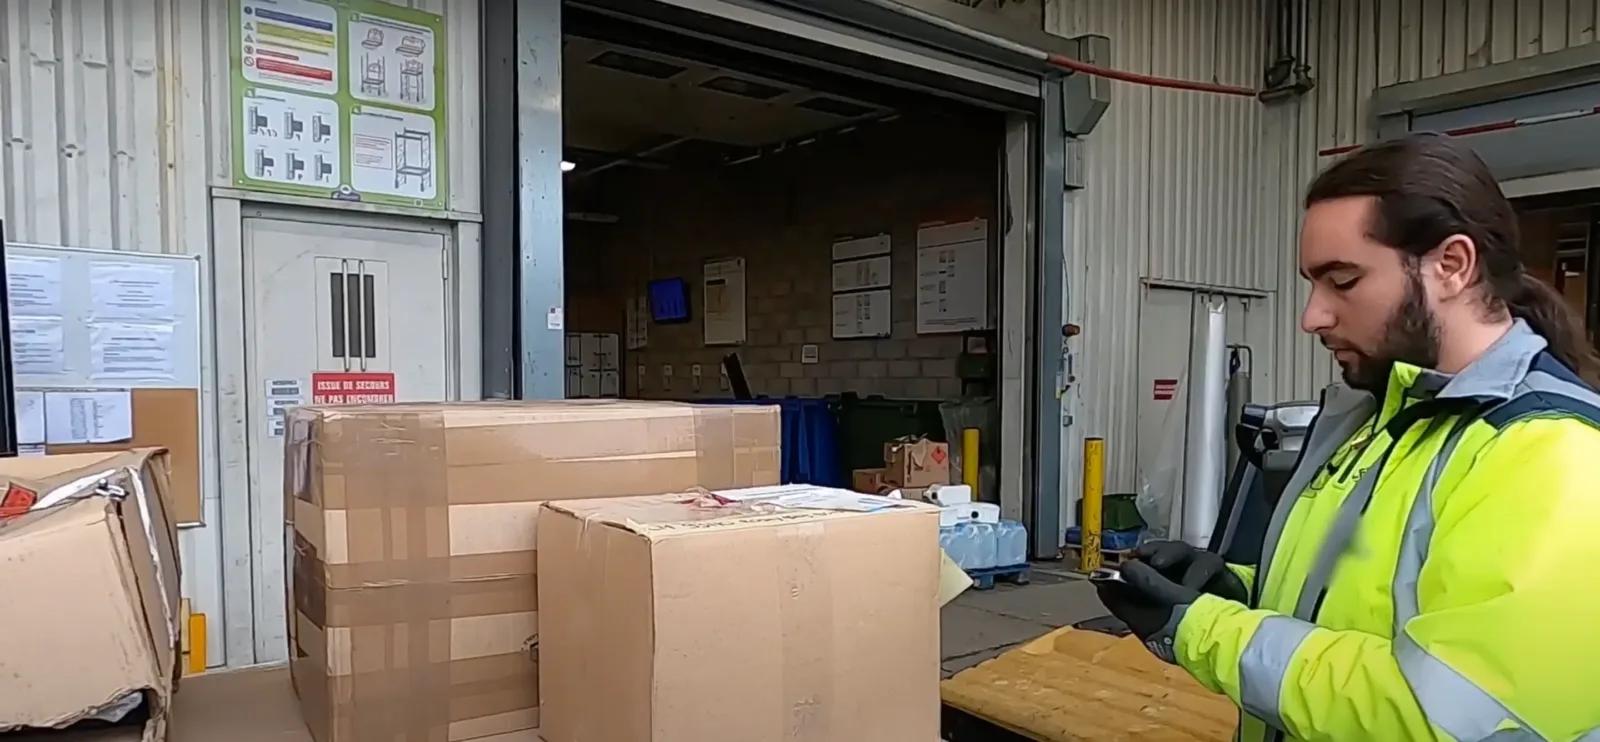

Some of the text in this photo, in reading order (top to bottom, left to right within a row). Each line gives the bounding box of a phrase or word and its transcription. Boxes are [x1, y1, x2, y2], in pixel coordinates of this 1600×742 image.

[317, 380, 390, 390] ISSUE DE SECOURS
[314, 394, 325, 405] NE
[328, 394, 345, 404] PAS
